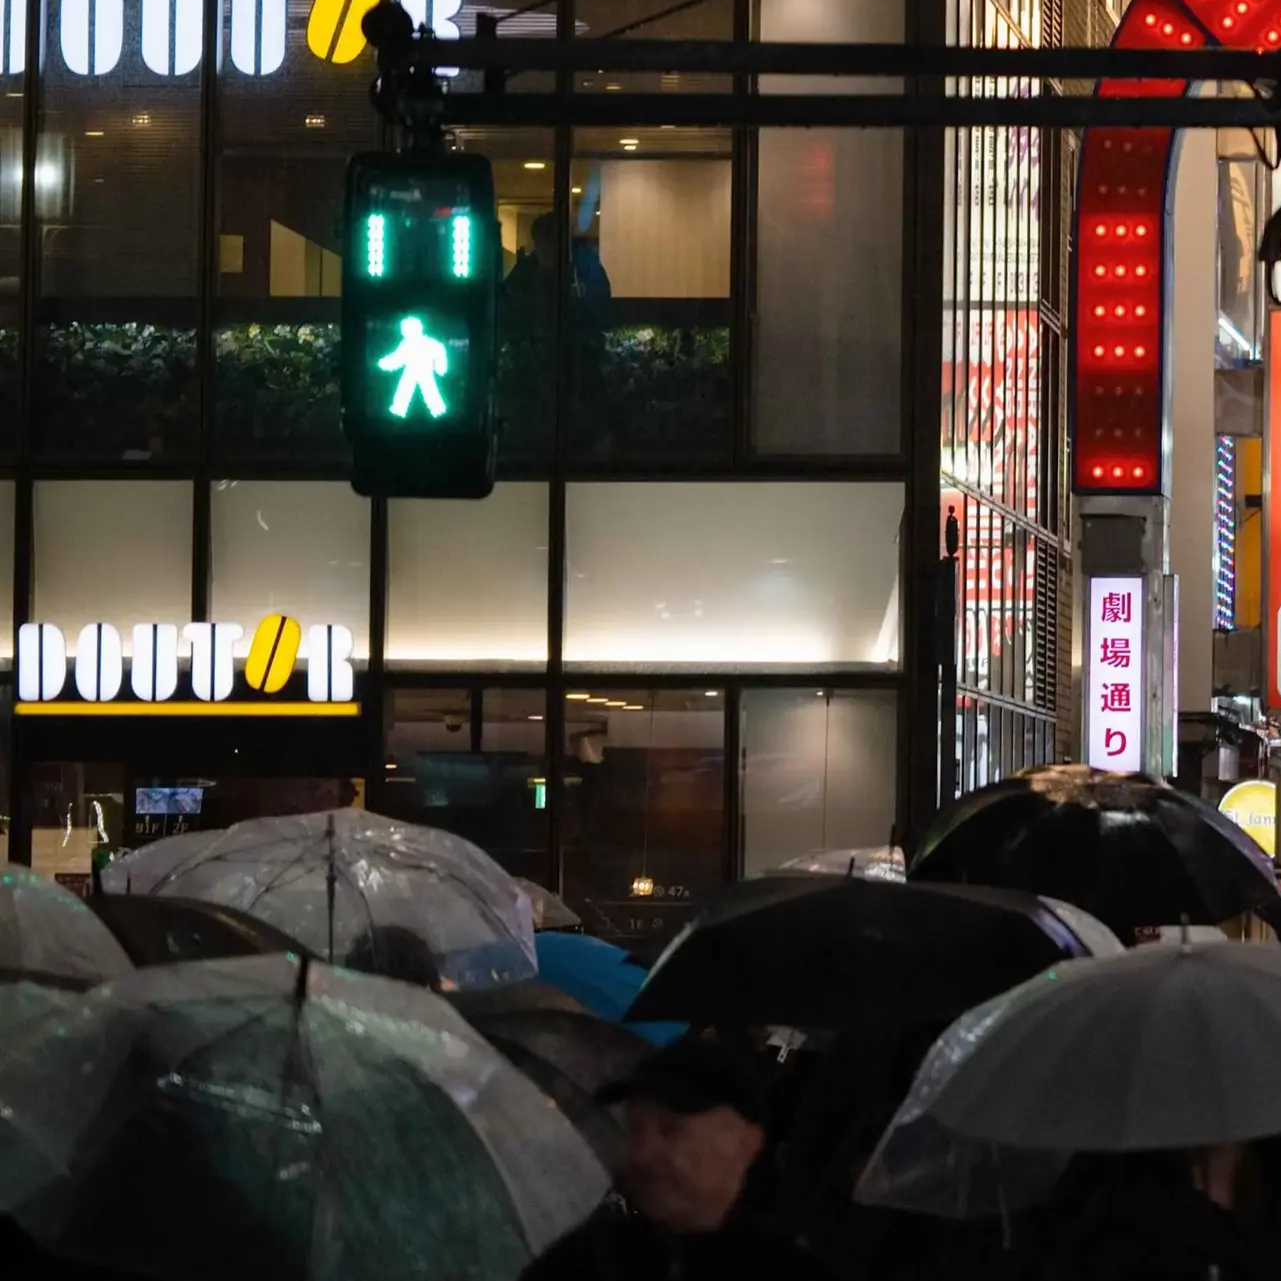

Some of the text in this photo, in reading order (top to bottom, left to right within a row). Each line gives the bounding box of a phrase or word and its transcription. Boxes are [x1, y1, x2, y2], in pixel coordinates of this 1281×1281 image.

[18, 615, 356, 703] DOUTOR
[1100, 592, 1132, 756] 劇場通り
